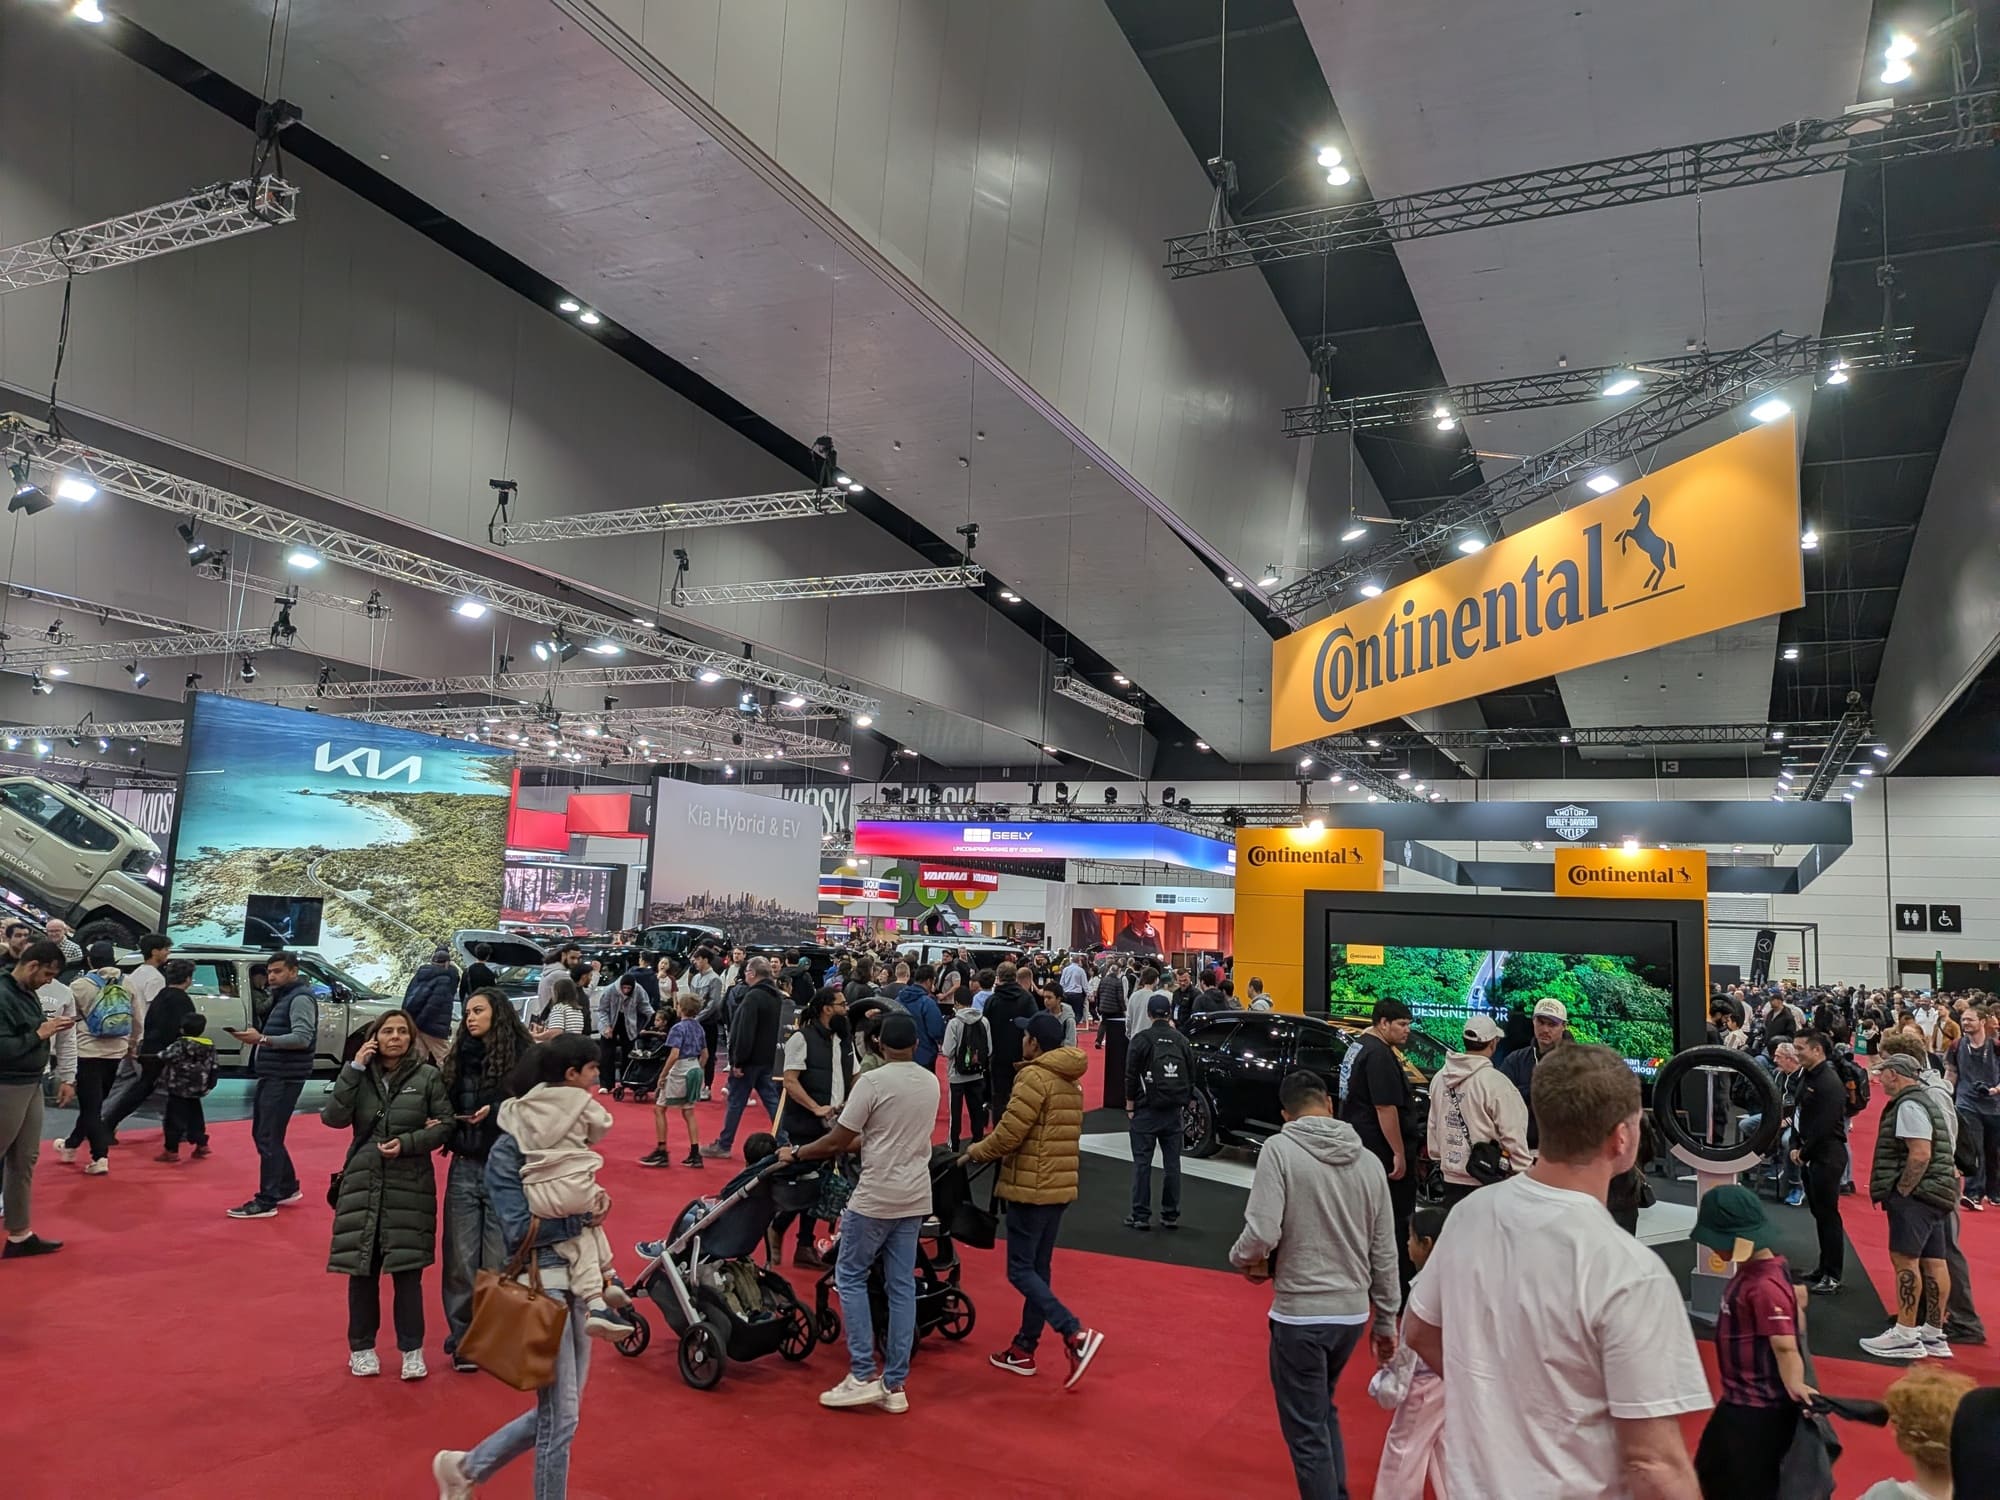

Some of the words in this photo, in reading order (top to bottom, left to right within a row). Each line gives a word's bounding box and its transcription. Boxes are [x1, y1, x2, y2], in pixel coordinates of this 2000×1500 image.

[1313, 523, 1608, 723] Continental
[1662, 761, 1679, 772] 13
[1558, 808, 1585, 816] MOTOR
[688, 802, 711, 827] Kia
[716, 807, 765, 836] Hybrid
[769, 817, 778, 836] &
[782, 819, 800, 839] EV
[1548, 818, 1595, 826] HARLEY-DAVIDSON
[992, 831, 1033, 840] GEELY
[1559, 829, 1586, 838] CYCLES
[1248, 845, 1346, 867] Continental
[923, 871, 968, 881] YAKIMA
[973, 873, 997, 884] YAKIMA
[1568, 865, 1674, 886] Continental
[1412, 1002, 1475, 1019] DESIGNED
